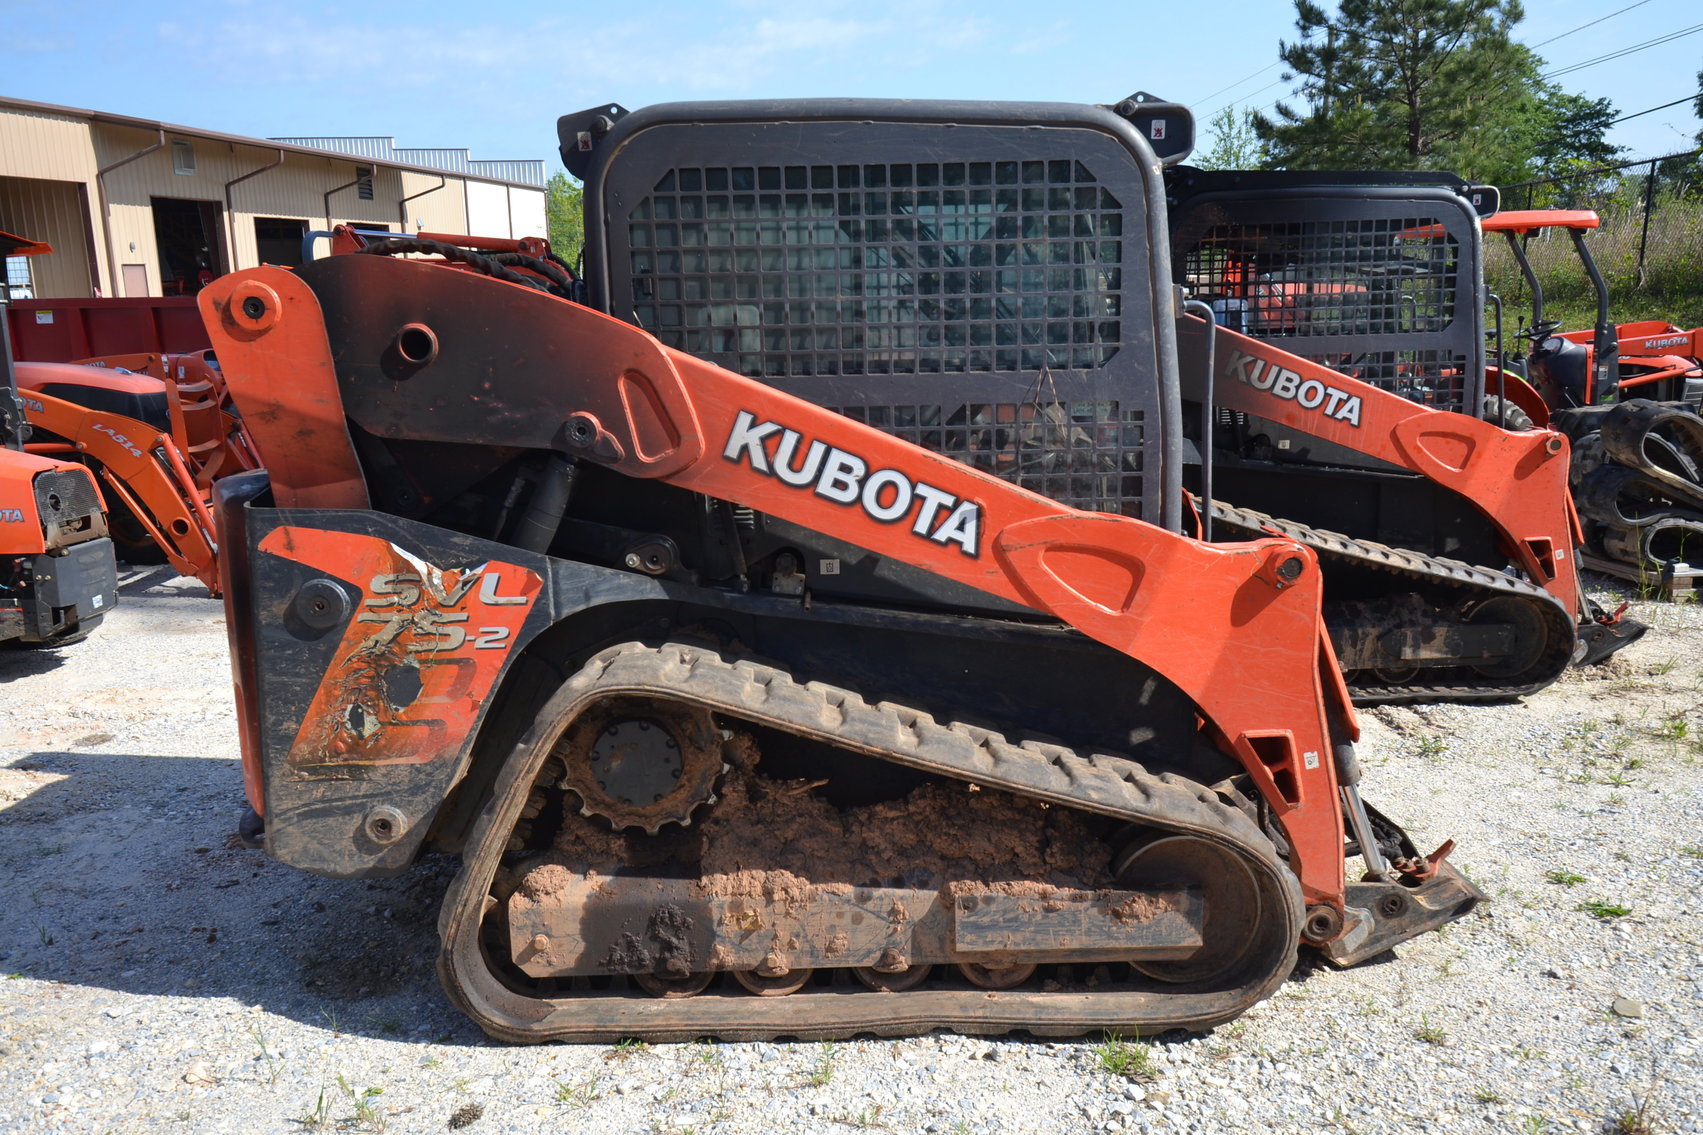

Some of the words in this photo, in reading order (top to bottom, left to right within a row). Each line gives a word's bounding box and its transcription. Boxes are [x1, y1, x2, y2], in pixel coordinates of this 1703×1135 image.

[1645, 336, 1688, 349] KUBOTA
[1224, 350, 1362, 427] KUBOTA
[92, 424, 143, 457] LA514
[723, 409, 980, 557] KUBOTA
[364, 572, 528, 607] SVL
